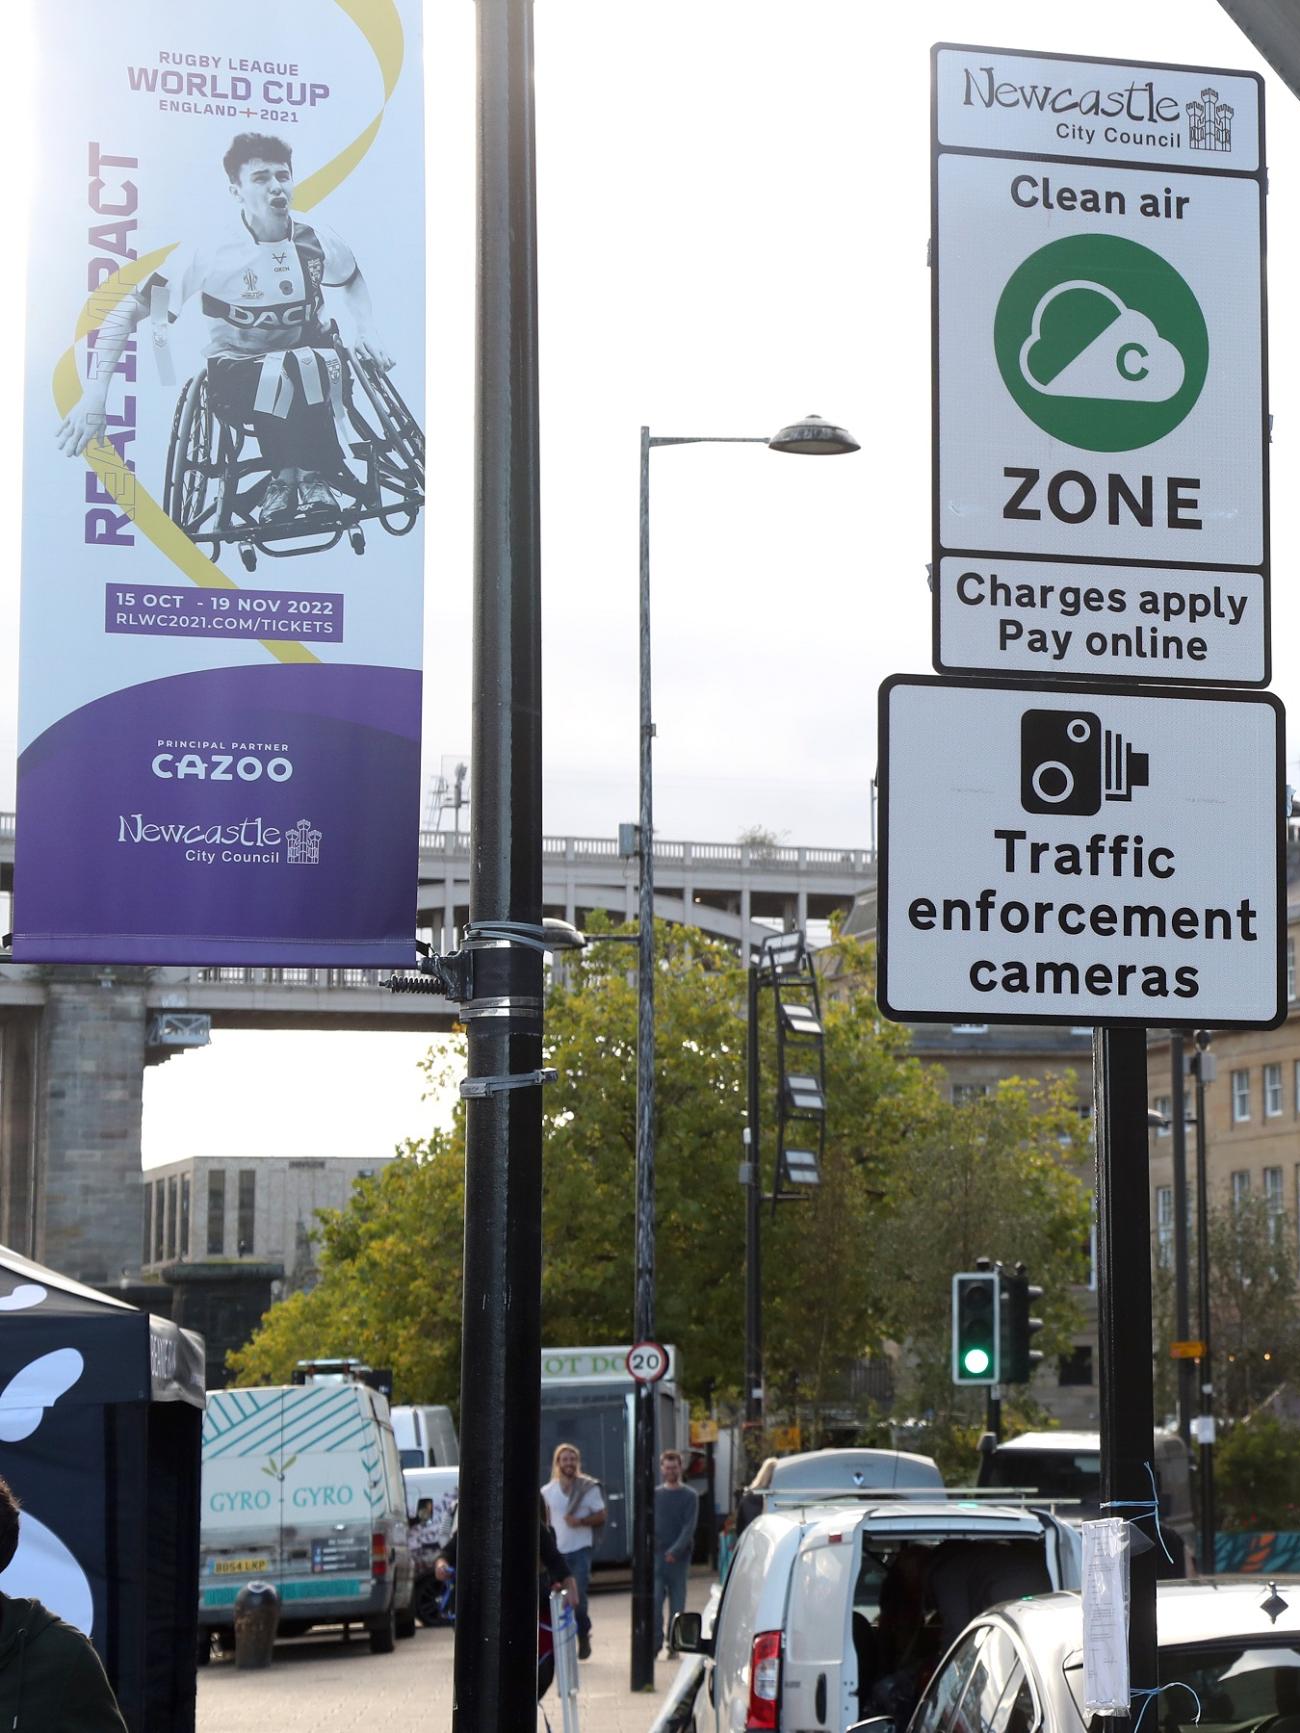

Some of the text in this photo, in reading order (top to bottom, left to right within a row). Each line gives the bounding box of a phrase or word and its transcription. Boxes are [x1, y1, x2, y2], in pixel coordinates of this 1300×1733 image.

[159, 51, 299, 76] RUGBY LEAGUE
[127, 66, 330, 107] WORLD CUP
[962, 67, 1181, 124] Newcastle
[159, 99, 299, 123] ENGLAND 2021
[1056, 122, 1181, 148] City Council
[1010, 174, 1190, 220] Clean air
[228, 303, 312, 327] DACI
[84, 141, 139, 547] REAL IMPACT
[1115, 342, 1149, 382] C
[1003, 467, 1203, 531] ZONE
[116, 592, 136, 606] 15
[142, 594, 184, 608] OCT
[210, 597, 230, 610] 19
[238, 598, 281, 612] NOV
[287, 600, 334, 615] 2022
[956, 572, 1248, 625] Charges apply
[116, 612, 334, 633] RLWC2021.COM/TICKETS
[999, 619, 1208, 661] Pay online
[157, 739, 289, 752] PRINCIPAL PARTNER
[151, 753, 294, 783] CAZOO
[117, 813, 281, 847] Newcastle
[185, 849, 280, 865] City Council
[994, 829, 1176, 879] Traffic
[908, 889, 1258, 942] enforcement
[969, 959, 1199, 998] cameras
[544, 1355, 627, 1376] OT DO
[632, 1354, 660, 1370] 20
[209, 1485, 354, 1512] GYRO GYRO
